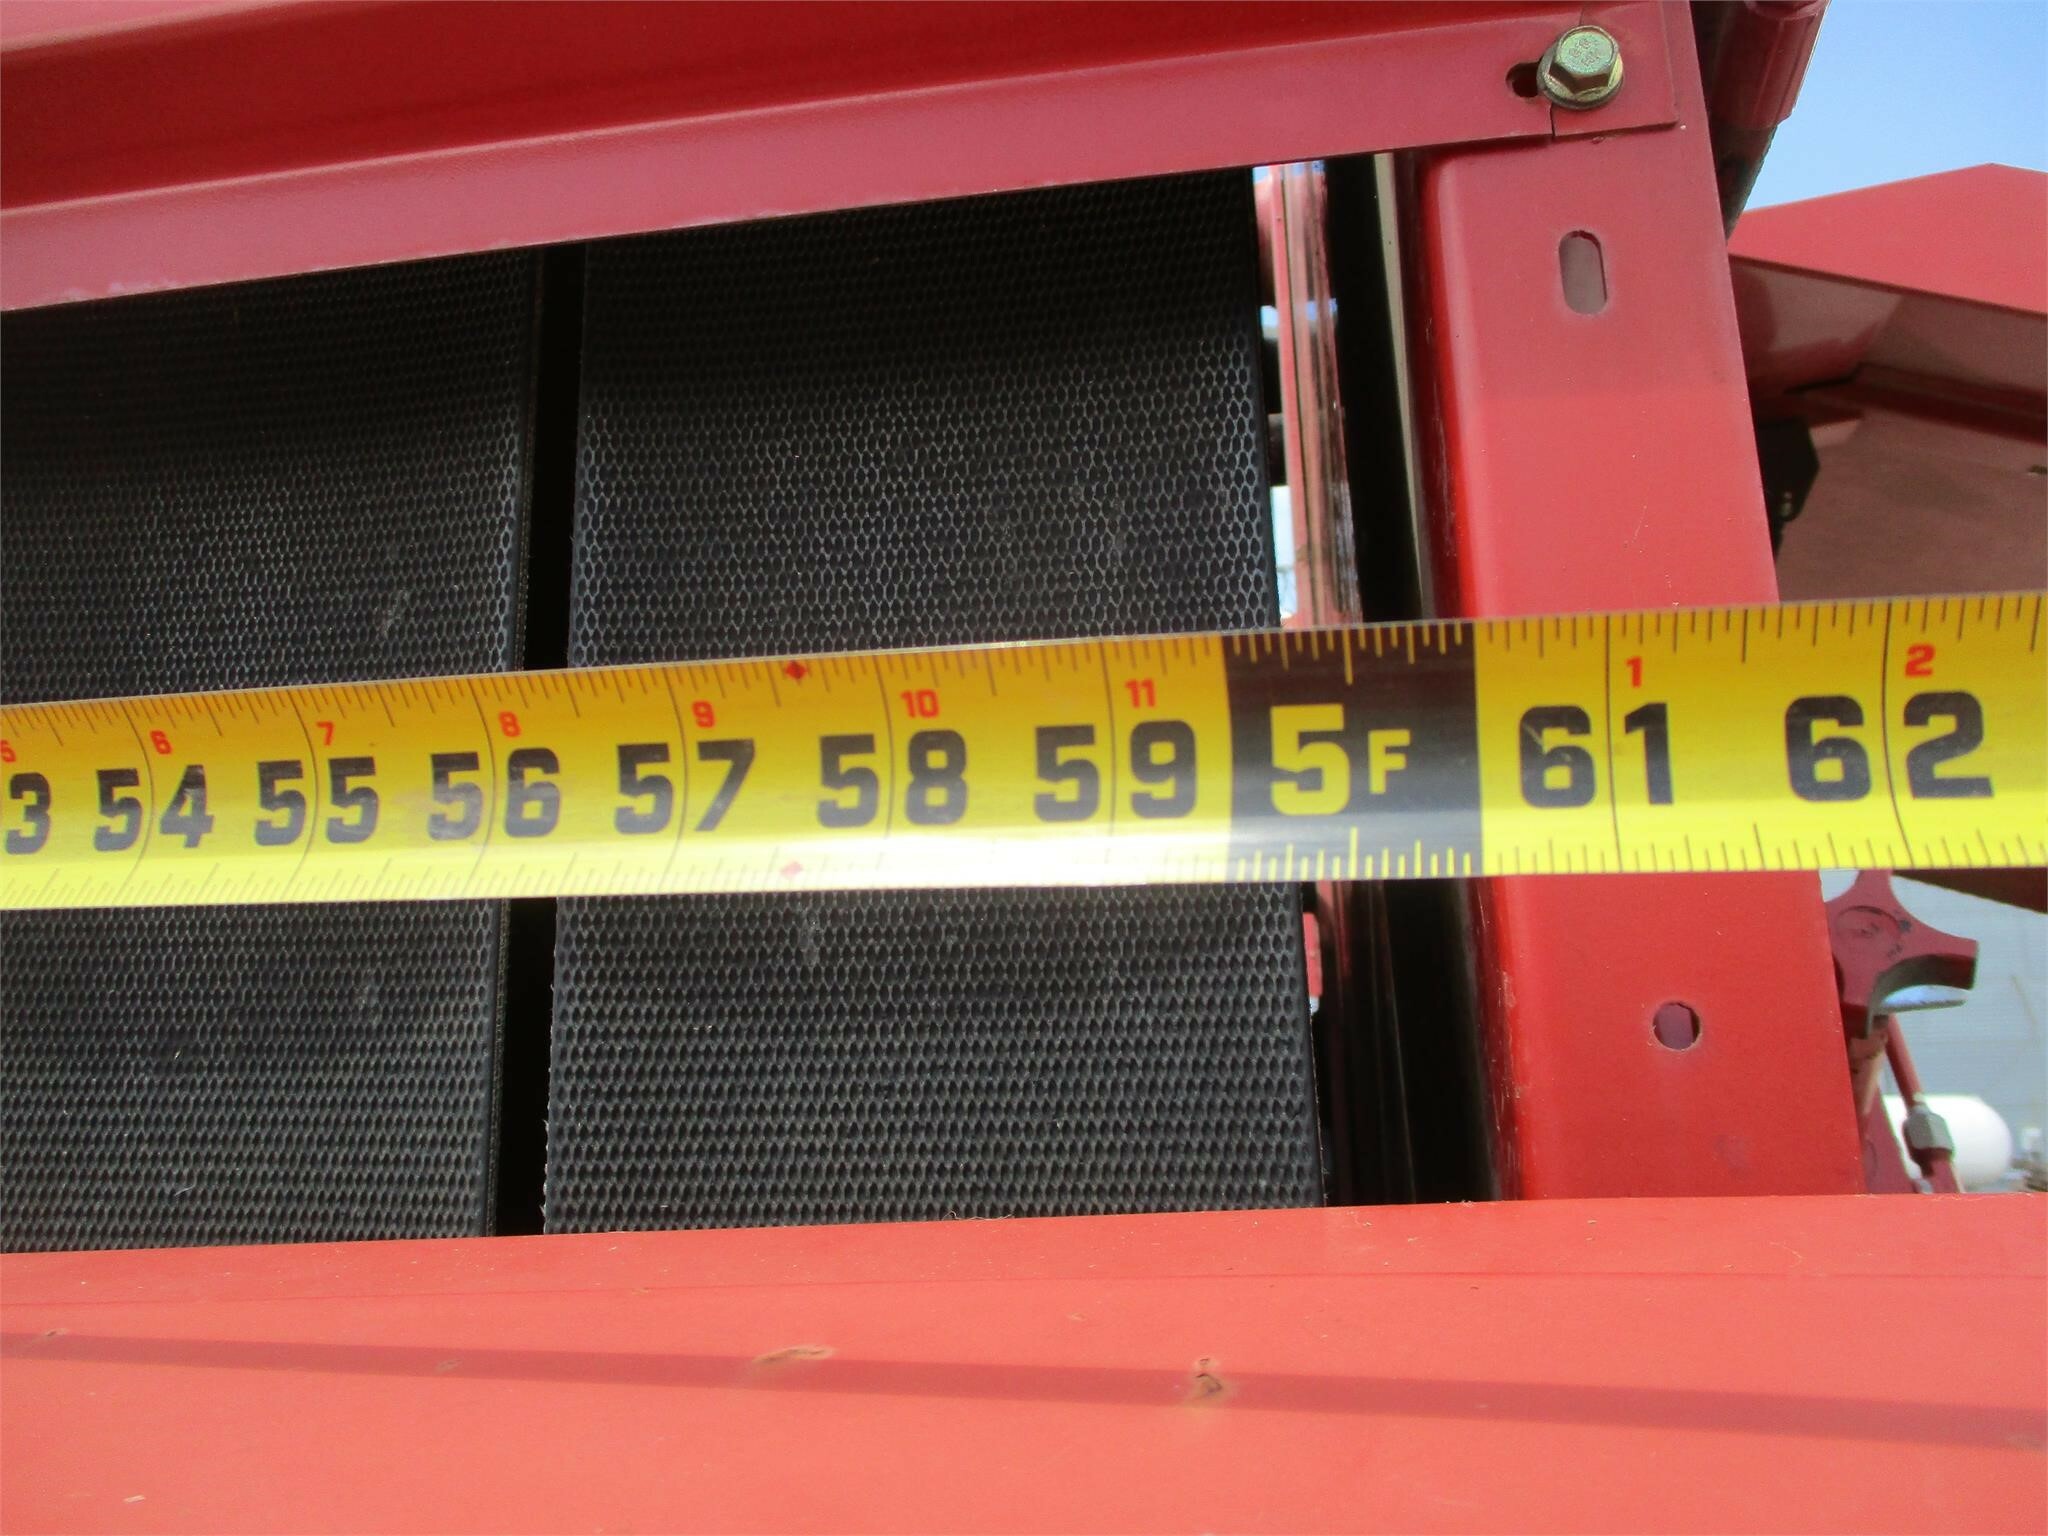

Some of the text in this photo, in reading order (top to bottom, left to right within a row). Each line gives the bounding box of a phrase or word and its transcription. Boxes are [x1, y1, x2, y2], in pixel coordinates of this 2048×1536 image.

[1626, 656, 1643, 688] 1
[1904, 643, 1936, 678] 2
[692, 701, 716, 728] 9
[901, 689, 940, 718] 10
[1126, 679, 1157, 708] 11
[149, 730, 173, 755] 6
[317, 721, 335, 746] 7
[500, 711, 521, 738] 8
[1518, 702, 1675, 808] 61
[1784, 691, 1995, 803] 62
[254, 756, 380, 846] 55
[427, 747, 561, 841] 56
[614, 738, 757, 834] 57
[817, 729, 968, 829] 58
[1034, 719, 1198, 823] 59
[93, 764, 214, 851] 54
